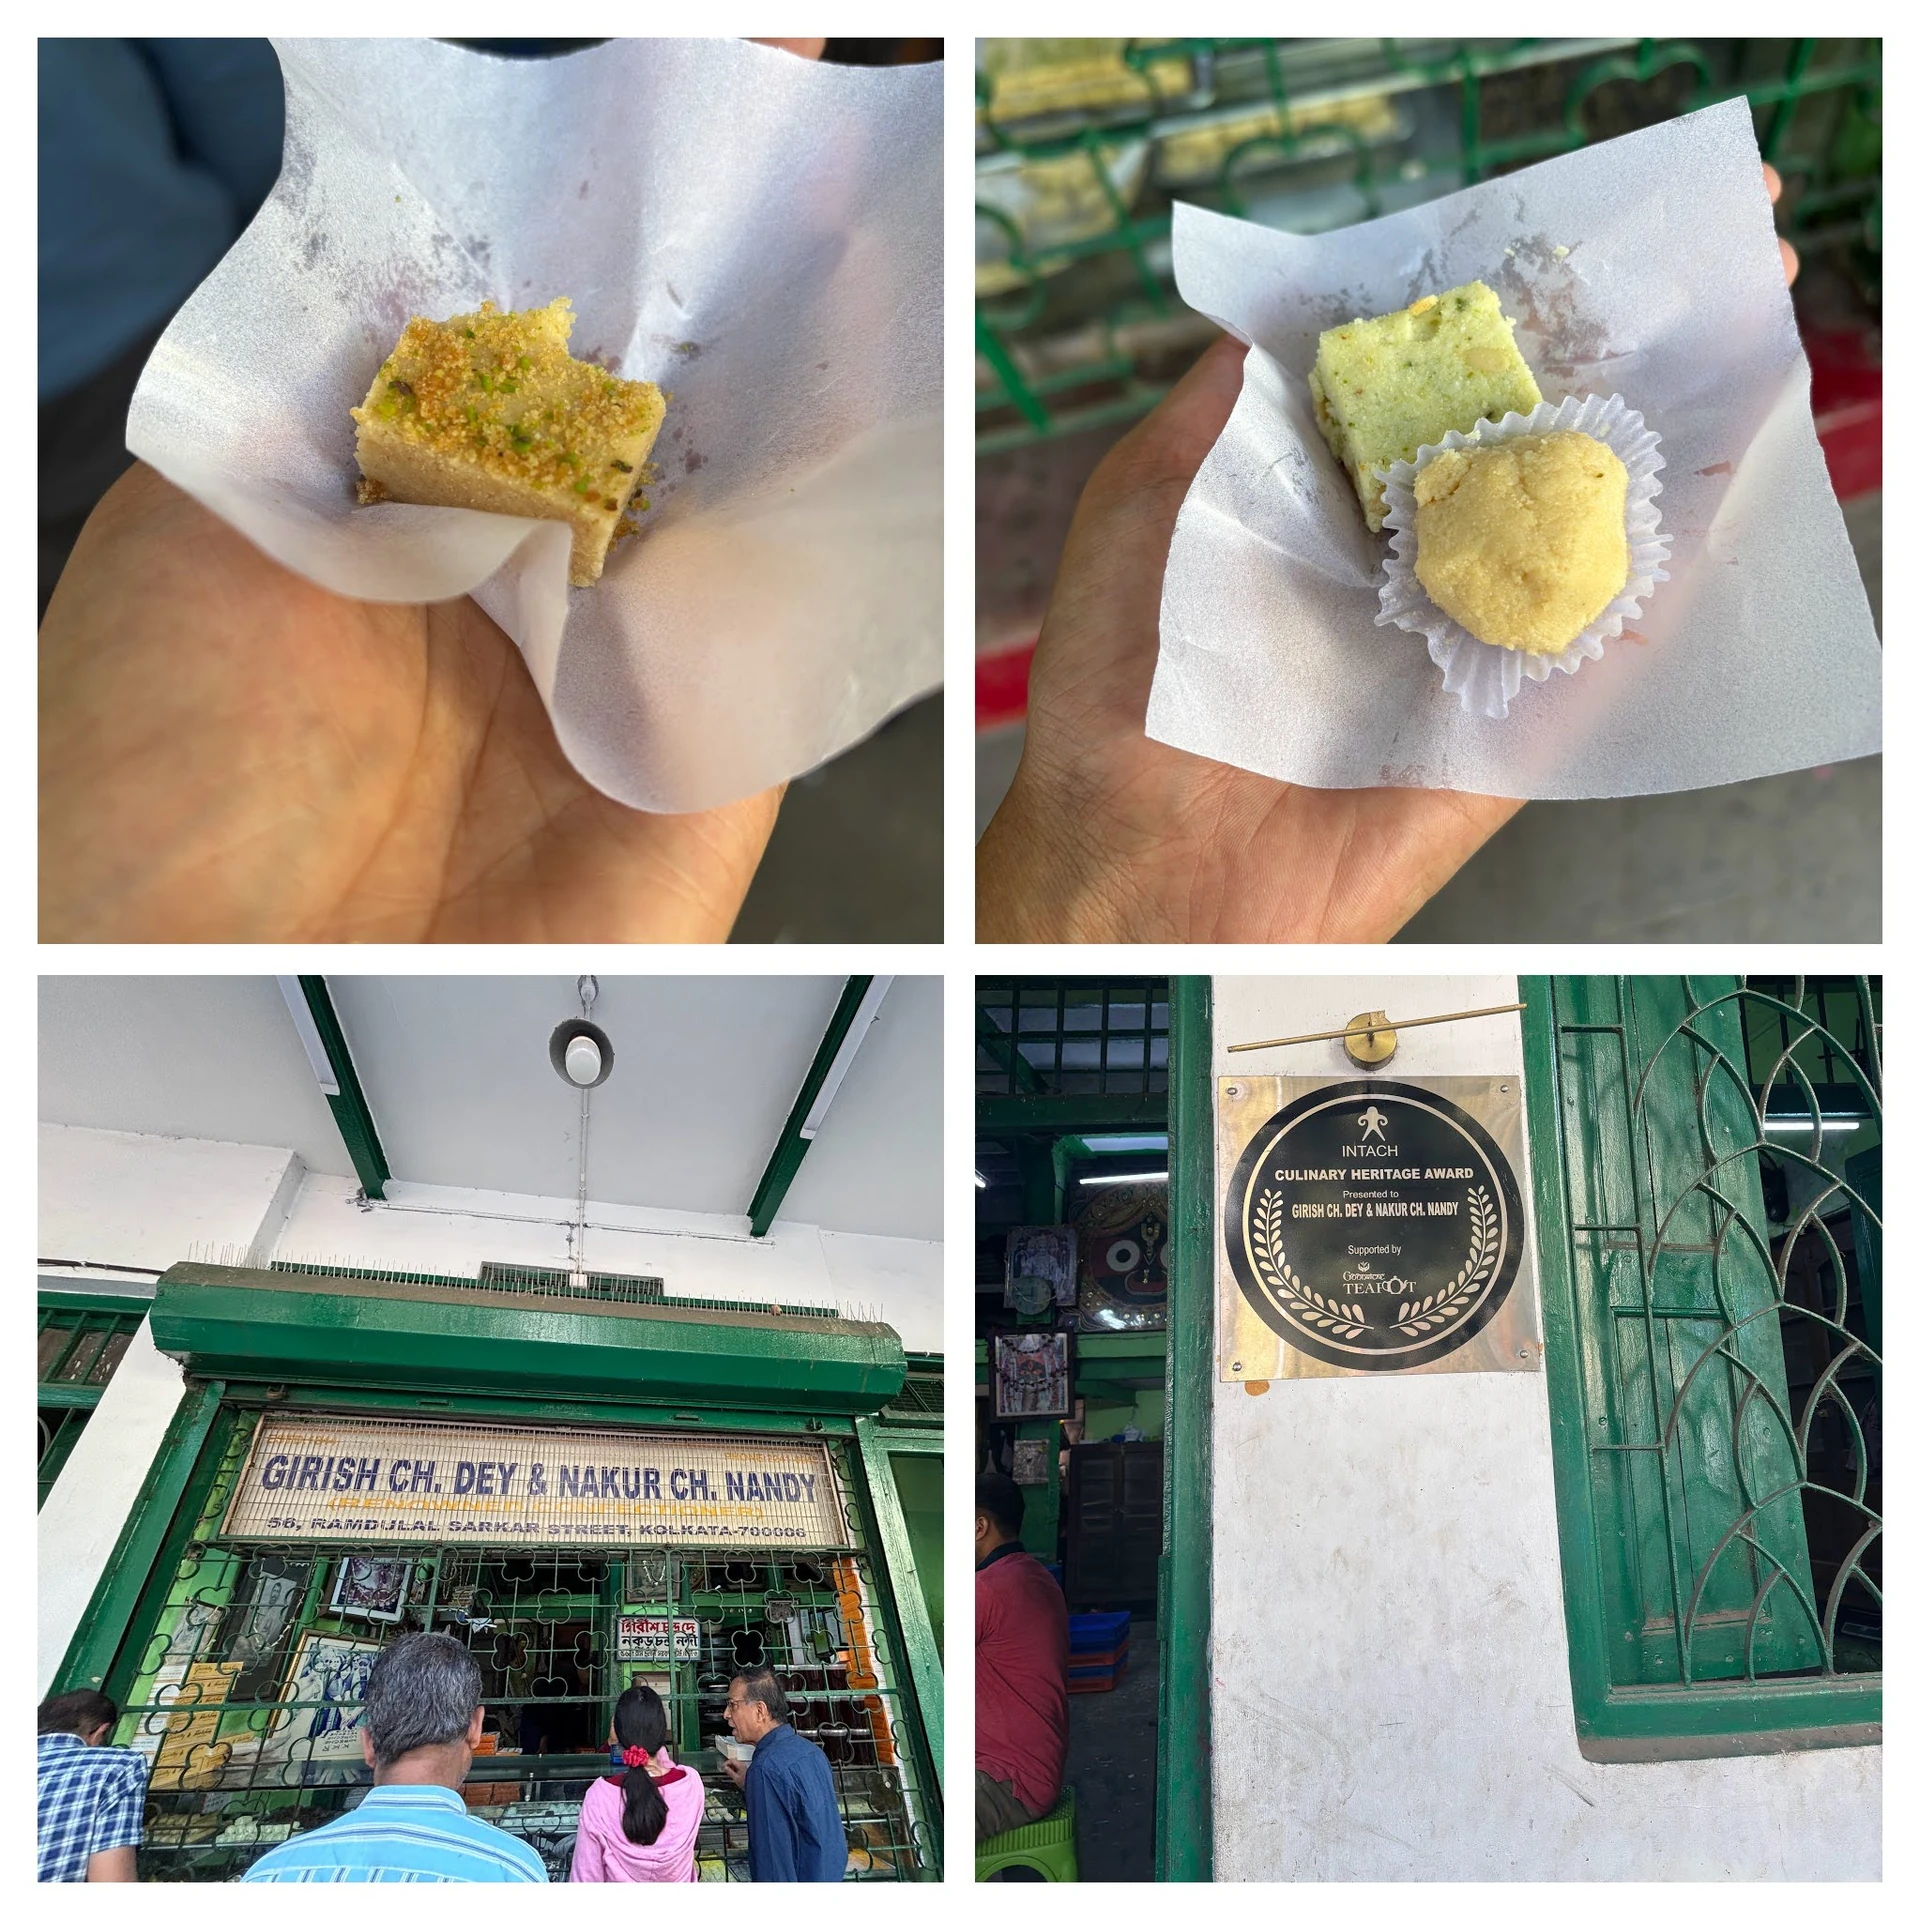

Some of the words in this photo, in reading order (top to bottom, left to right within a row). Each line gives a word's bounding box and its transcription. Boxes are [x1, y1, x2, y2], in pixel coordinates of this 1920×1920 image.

[1342, 1145, 1398, 1157] INTACH
[1274, 1168, 1347, 1181] CULINARY
[1351, 1168, 1420, 1181] HERITAGE
[1424, 1167, 1474, 1179] AWARD
[1342, 1190, 1387, 1199] Presented
[1390, 1190, 1399, 1198] to
[1292, 1203, 1324, 1218] GIRISH
[1327, 1203, 1343, 1218] CH.
[1345, 1203, 1364, 1217] DEY
[1366, 1203, 1373, 1217] &
[1375, 1202, 1408, 1217] NAKUR
[1410, 1202, 1426, 1216] CH.
[1428, 1202, 1459, 1216] NANDY
[1347, 1244, 1389, 1256] Supported
[1391, 1244, 1401, 1256] by
[262, 1455, 380, 1491] GIRISH
[388, 1459, 442, 1493] CH.
[454, 1461, 519, 1495] DEY
[528, 1462, 547, 1496] &
[559, 1464, 663, 1500] NAKUR
[670, 1468, 717, 1501] CH.
[725, 1470, 816, 1503] NANDY
[267, 1517, 302, 1531] 56,
[310, 1517, 439, 1532] RAMDULAL
[448, 1520, 540, 1534] SARKAR
